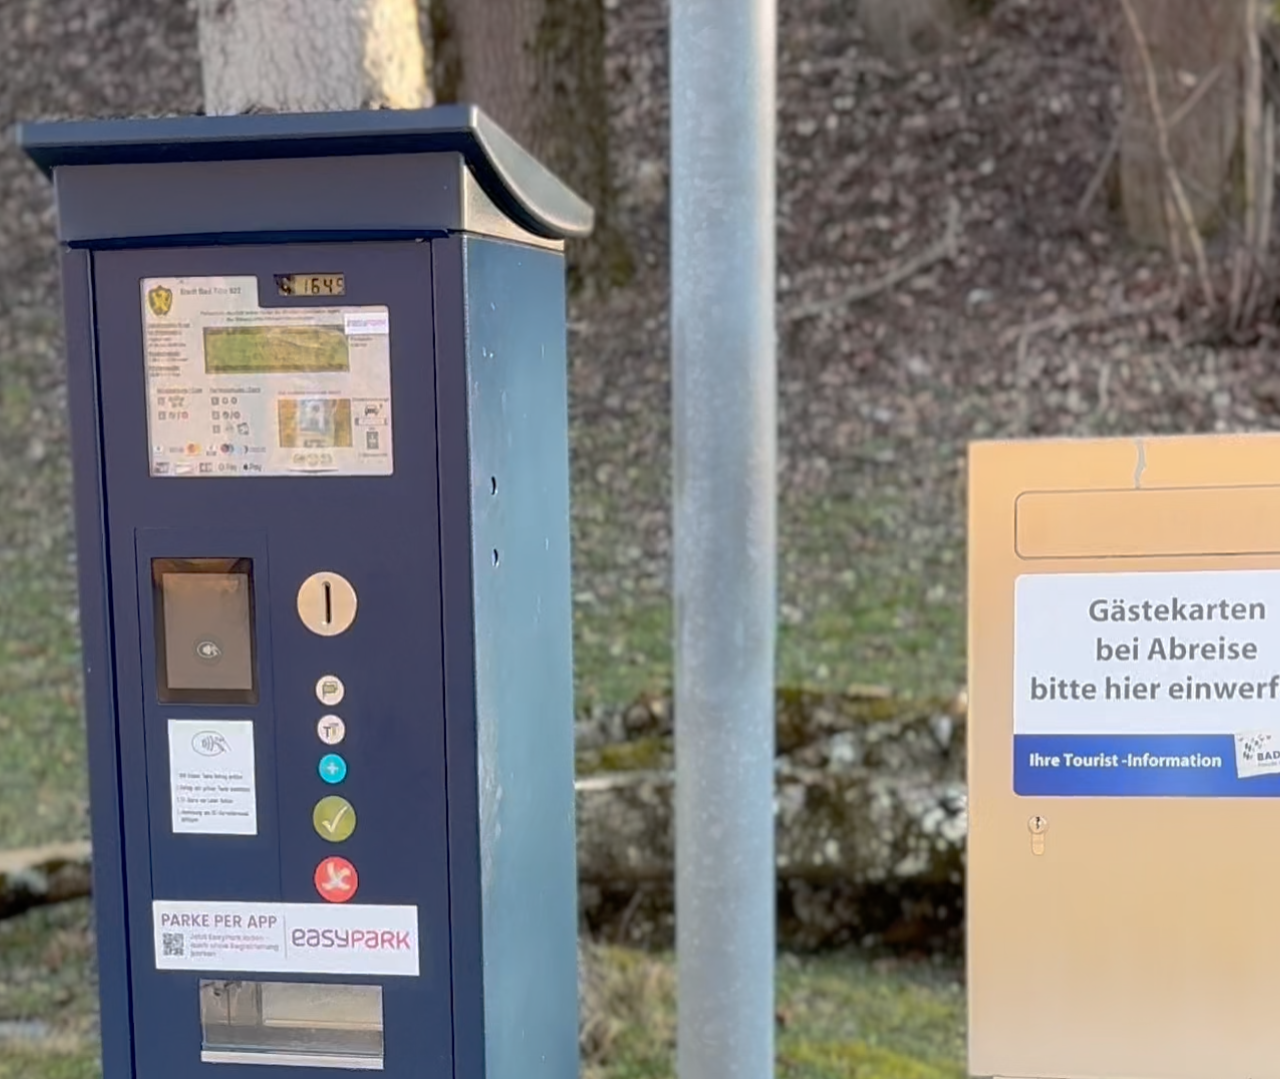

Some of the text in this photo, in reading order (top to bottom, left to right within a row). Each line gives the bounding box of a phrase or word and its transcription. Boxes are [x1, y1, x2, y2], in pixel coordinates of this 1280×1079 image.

[1088, 597, 1266, 622] Gästekarten
[1096, 637, 1258, 661] bei Abreise
[1030, 677, 1097, 700] bitte
[1105, 676, 1161, 700] hier
[1029, 753, 1060, 768] Ihre
[1064, 753, 1119, 768] Tourist
[1257, 750, 1280, 762] BAD
[161, 913, 277, 929] PARKE PER APP
